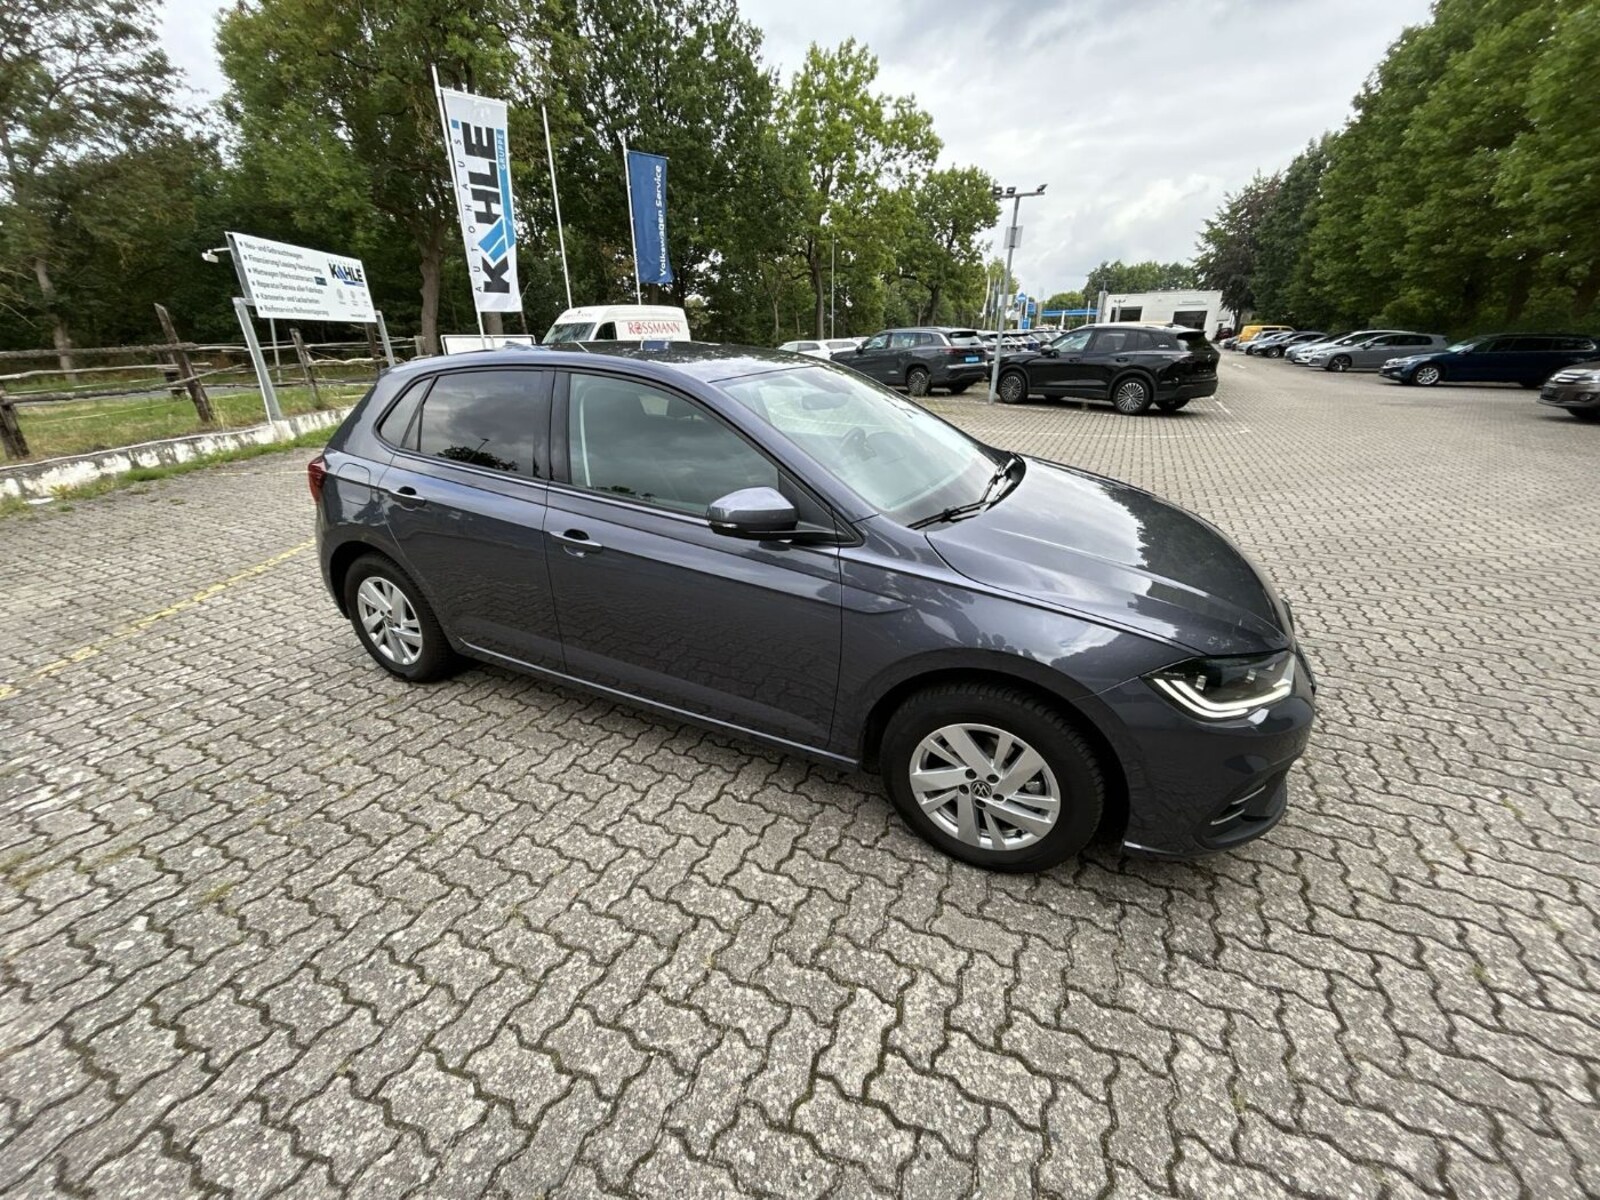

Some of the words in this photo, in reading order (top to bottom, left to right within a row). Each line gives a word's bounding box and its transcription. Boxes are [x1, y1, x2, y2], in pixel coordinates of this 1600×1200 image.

[496, 133, 506, 170] GRUPPE
[655, 165, 664, 207] Service
[454, 138, 482, 292] AUTOHAUS
[461, 121, 511, 294] KAHLE
[658, 209, 667, 277] Volkswagen
[328, 263, 364, 283] KAHLE
[628, 320, 680, 335] ROSSMANN
